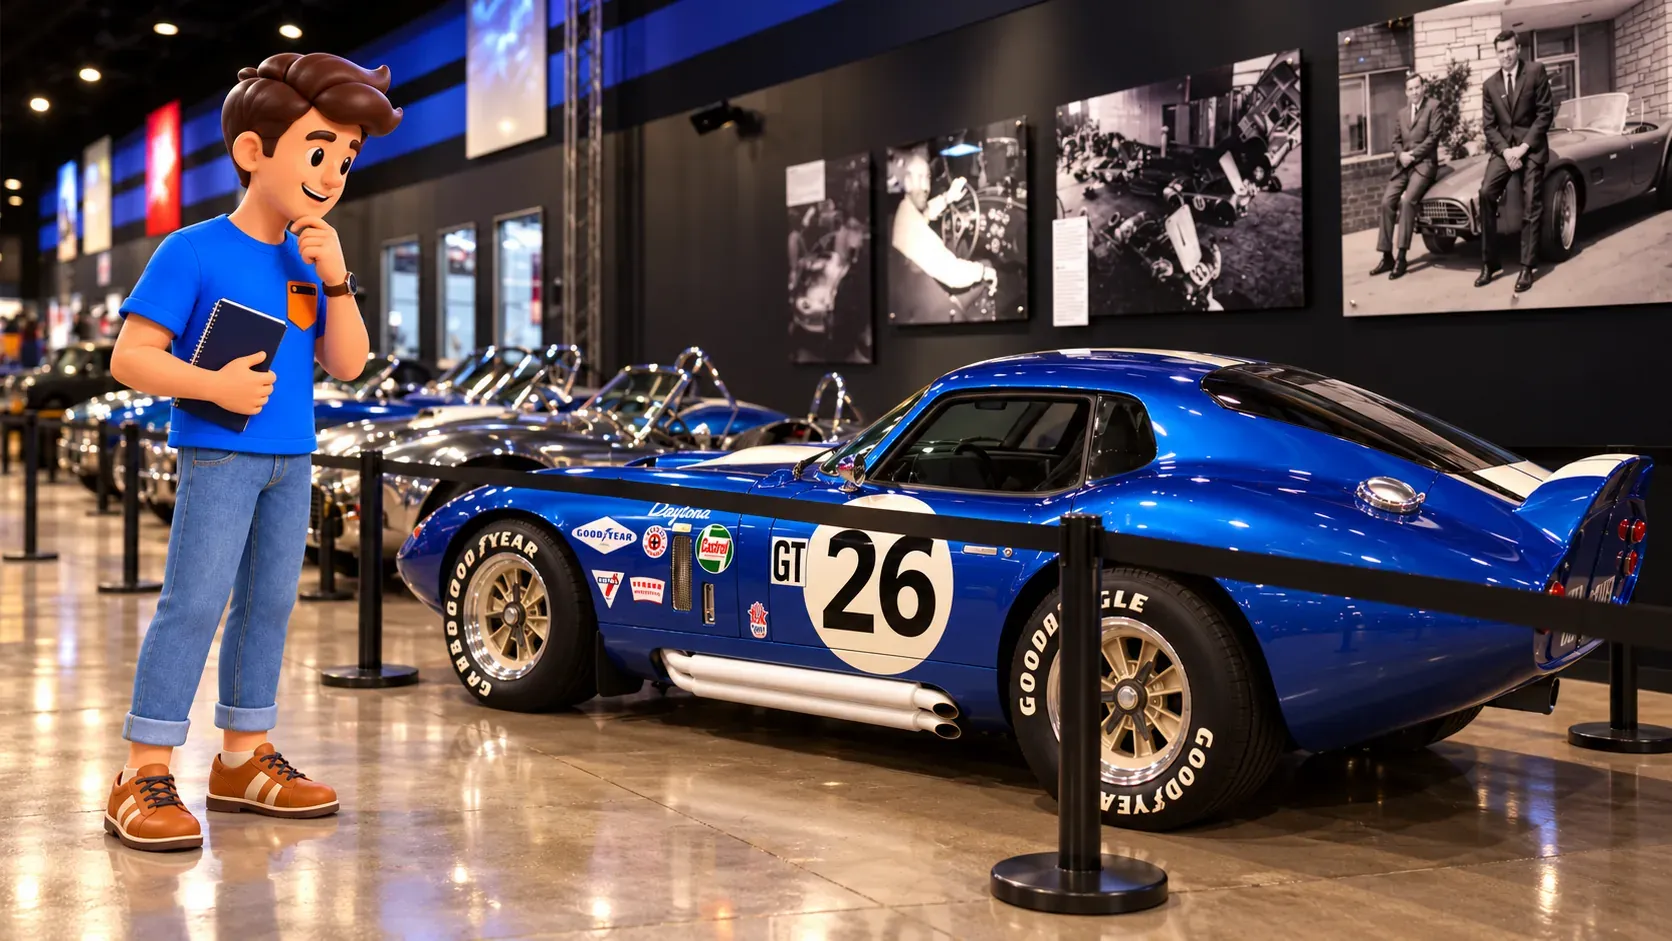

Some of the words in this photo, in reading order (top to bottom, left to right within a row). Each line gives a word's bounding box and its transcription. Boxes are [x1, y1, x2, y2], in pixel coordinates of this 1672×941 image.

[648, 502, 711, 526] Daytona
[576, 527, 633, 542] GOODYEAR
[773, 540, 806, 583] GT
[823, 529, 936, 638] 26
